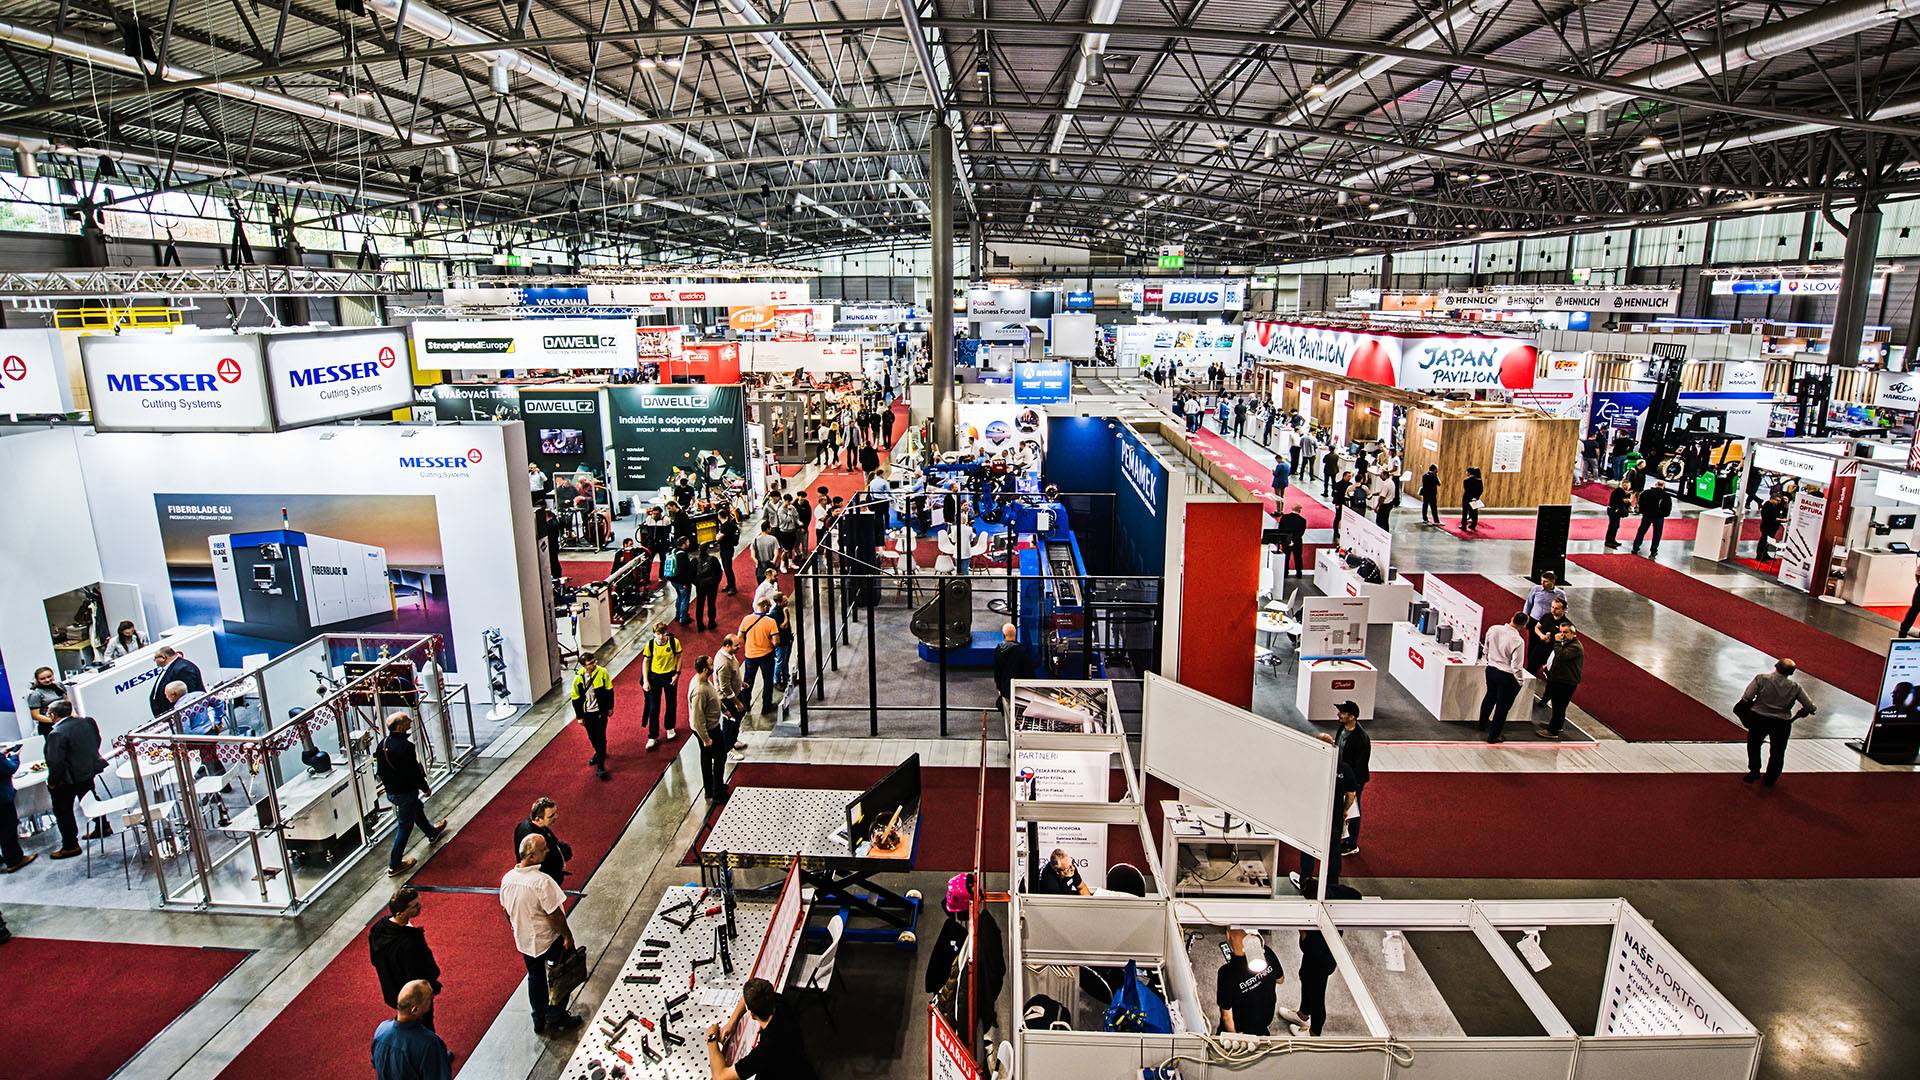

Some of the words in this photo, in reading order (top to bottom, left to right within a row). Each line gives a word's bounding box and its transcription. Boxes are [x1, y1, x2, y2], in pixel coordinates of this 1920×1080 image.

[1169, 291, 1219, 304] BIBUS
[1456, 296, 1498, 304] HENNLICH
[1563, 297, 1600, 307] HENNLICH
[1623, 297, 1669, 308] HENNLICH
[1299, 335, 1348, 368] PAVILION
[1419, 346, 1498, 370] JAPAN
[290, 361, 380, 388] MESSER
[1433, 367, 1502, 385] PAVILION
[107, 373, 219, 392] MESSER
[320, 387, 348, 401] Cutting
[350, 382, 383, 399] Systems
[1883, 393, 1917, 403] HANGCHA
[142, 398, 178, 411] Cutting
[179, 398, 222, 411] Systems
[527, 401, 576, 412] DAWELL
[643, 397, 690, 407] DAWELL
[619, 415, 657, 424] Indukční
[399, 456, 468, 469] MESSER
[1780, 457, 1815, 472] OERLIKON
[168, 505, 218, 514] FIBERBLADE
[219, 505, 232, 514] GU
[1801, 498, 1824, 509] BALINIT
[311, 565, 343, 577] FIBERBLADE
[115, 667, 164, 695] MESSE
[1624, 931, 1654, 968] NAŠE
[1631, 959, 1654, 988] Plechy
[939, 1027, 972, 1080] SVAŘUJ
